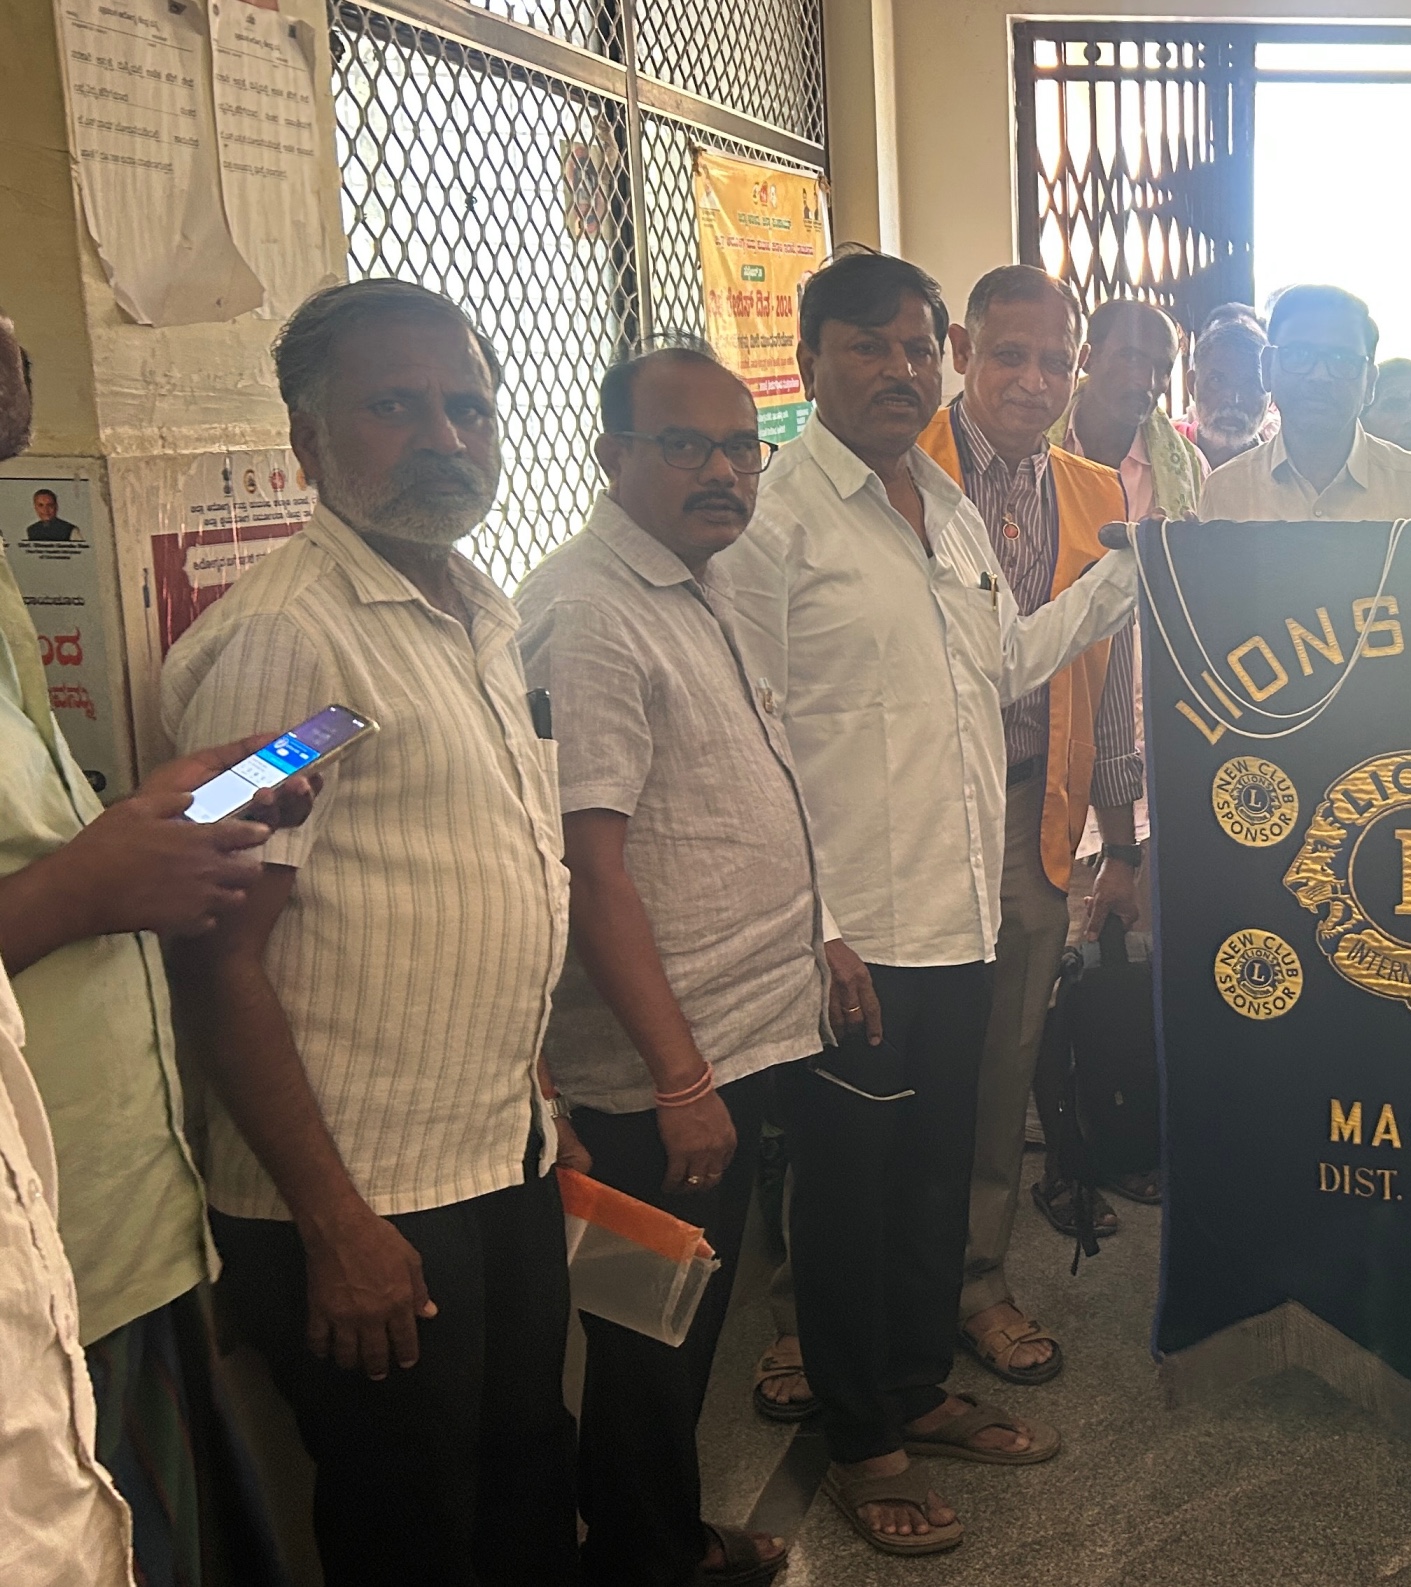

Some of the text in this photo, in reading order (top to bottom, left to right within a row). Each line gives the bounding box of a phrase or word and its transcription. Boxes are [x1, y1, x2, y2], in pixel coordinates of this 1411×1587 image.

[775, 294, 793, 318] 2024
[1175, 595, 1405, 746] LIONS
[1216, 759, 1295, 804] NEW CLUB
[1241, 775, 1273, 791] LIONS
[1248, 788, 1262, 808] L
[1216, 800, 1293, 843] SPONSOR
[1220, 932, 1299, 978] NEW CLUB
[1245, 949, 1277, 965] LIONS
[1251, 962, 1265, 982] L
[1220, 973, 1296, 1016] SPONSOR
[1318, 1162, 1403, 1201] DIST.
